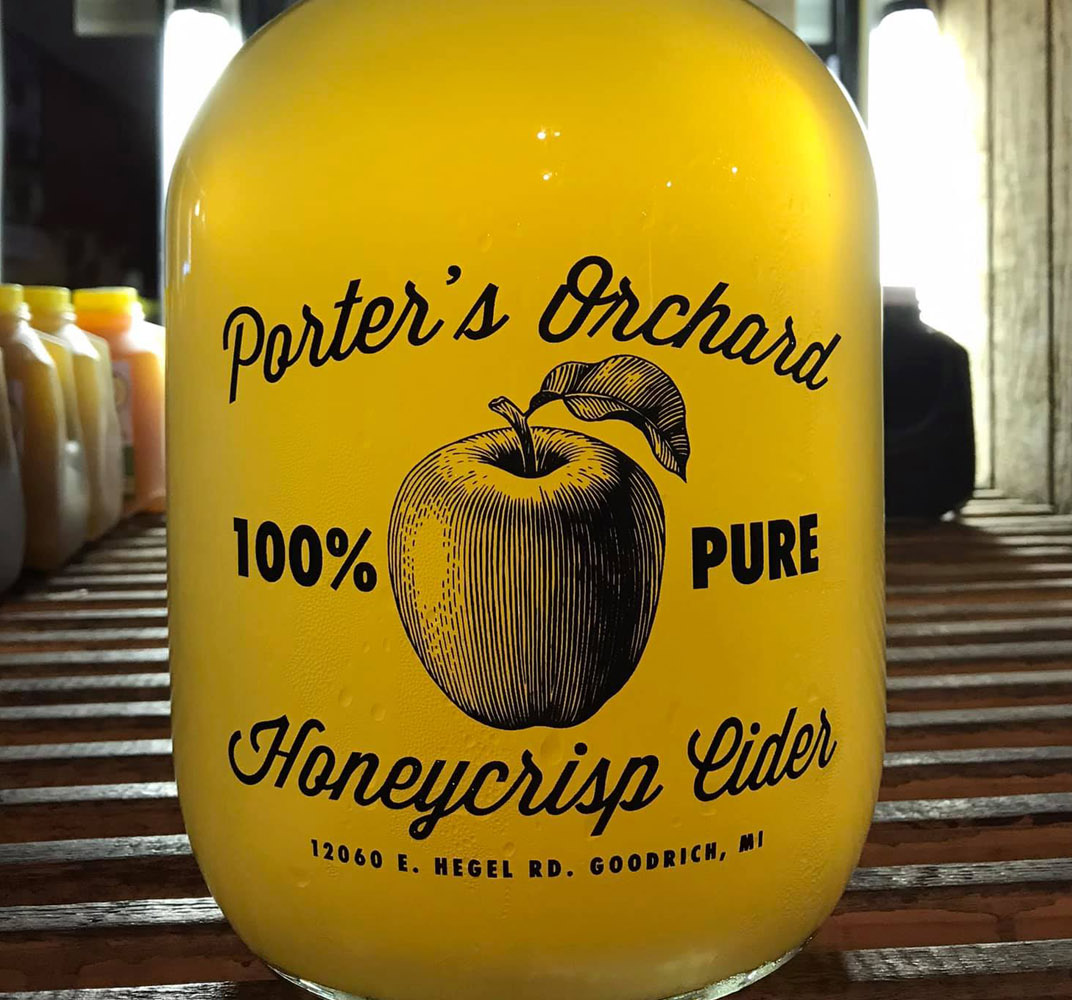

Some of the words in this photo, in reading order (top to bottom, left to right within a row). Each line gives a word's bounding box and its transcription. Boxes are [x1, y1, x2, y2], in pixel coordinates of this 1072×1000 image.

[223, 265, 510, 404] Porter's
[538, 255, 842, 391] Orchard
[233, 516, 378, 592] 100%
[691, 513, 820, 590] PURE
[228, 714, 664, 840] Honeycrisp
[687, 707, 838, 803] Cider
[310, 838, 384, 870] 12060
[397, 853, 420, 874] E.
[434, 857, 514, 879] HEGEL
[529, 859, 574, 880] RD.
[590, 841, 727, 876] GOODRICH,
[739, 830, 766, 855] MI
